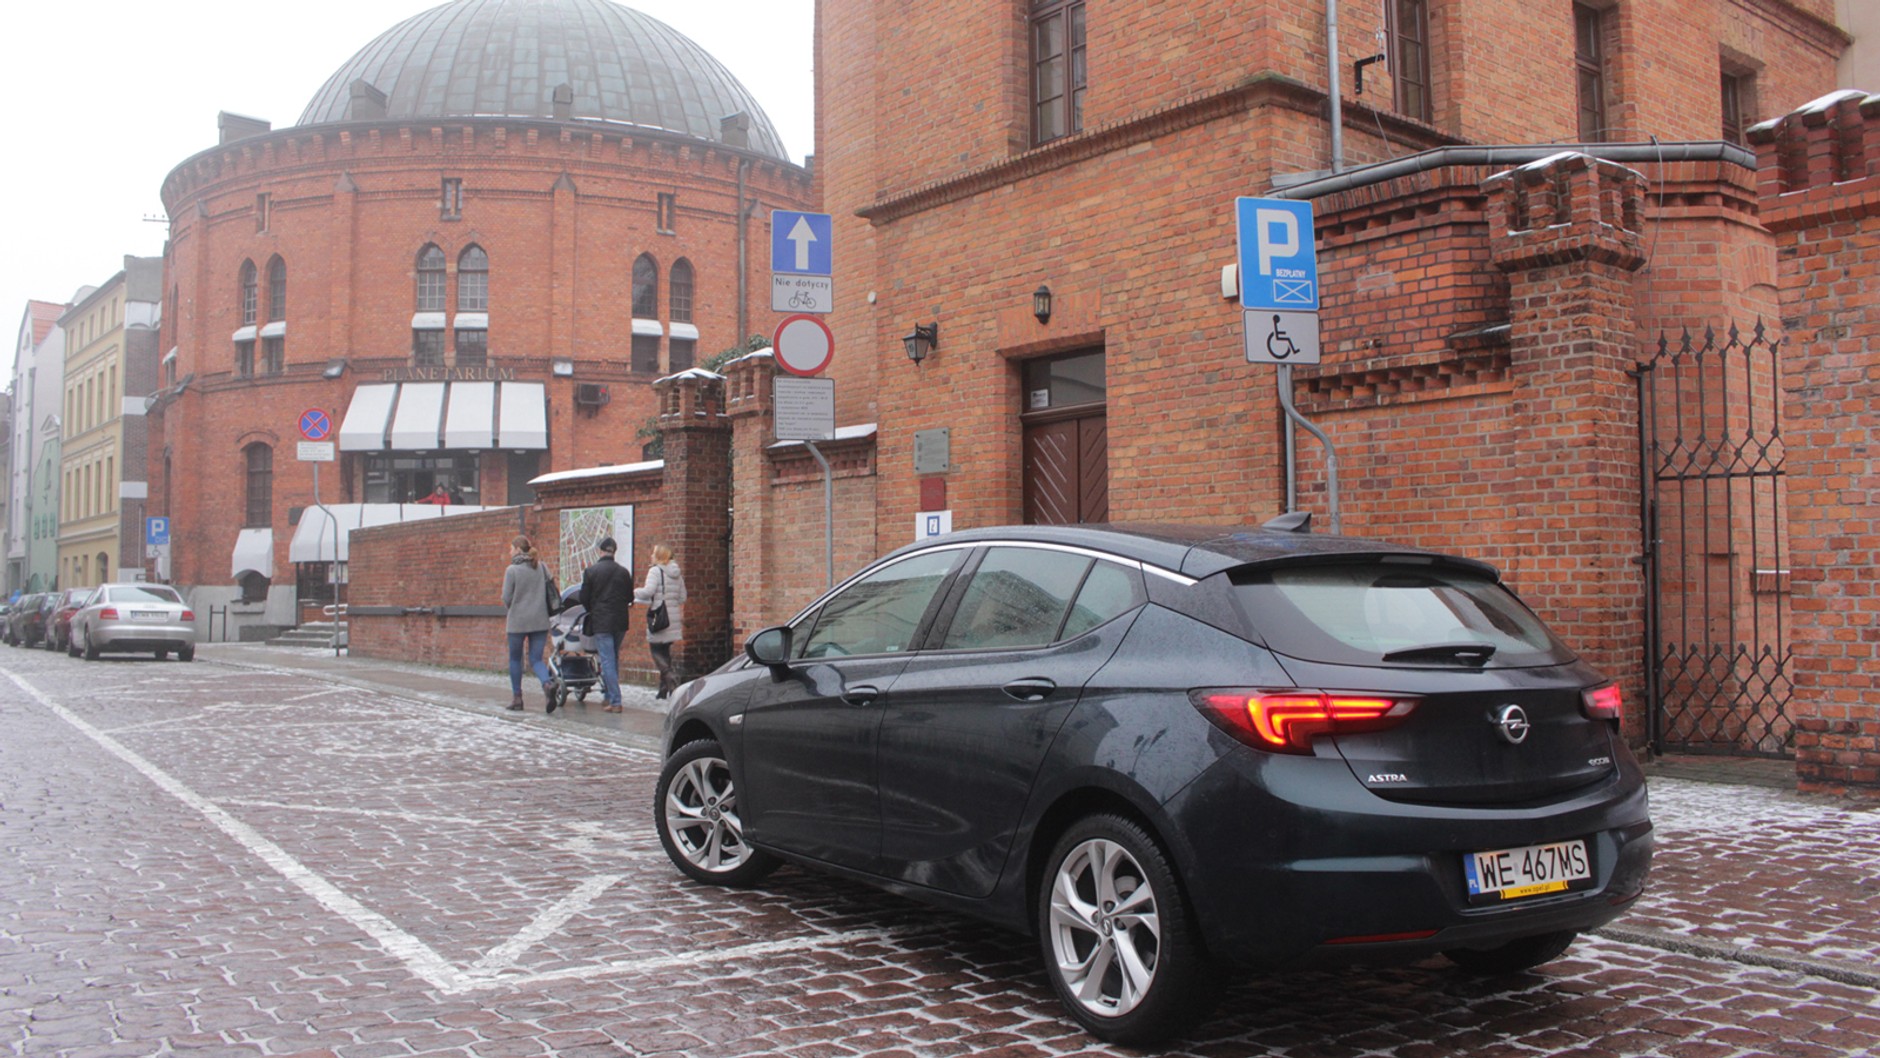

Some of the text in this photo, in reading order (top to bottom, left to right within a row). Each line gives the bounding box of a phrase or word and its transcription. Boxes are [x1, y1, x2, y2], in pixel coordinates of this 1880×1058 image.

[1256, 208, 1300, 275] P
[775, 278, 829, 290] Nie dotyczy
[383, 367, 515, 381] PLANETARIUM
[151, 519, 165, 537] P
[1367, 773, 1408, 783] ASTRA
[1479, 844, 1586, 889] WE 467MS
[1468, 878, 1478, 889] PL
